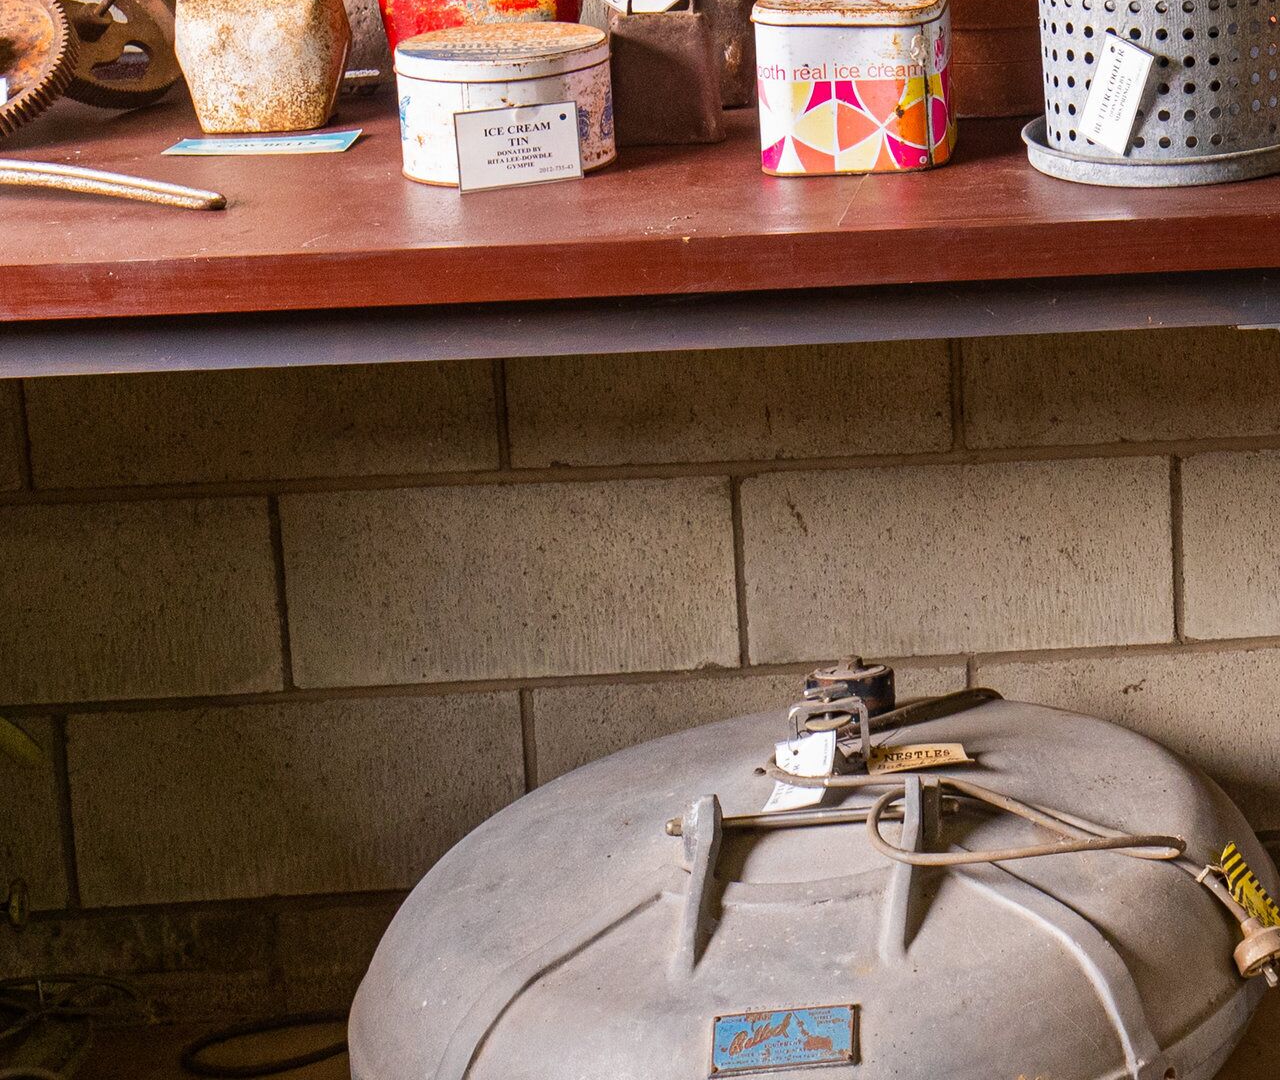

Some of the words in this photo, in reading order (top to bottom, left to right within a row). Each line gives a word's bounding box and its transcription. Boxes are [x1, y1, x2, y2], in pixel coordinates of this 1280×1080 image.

[793, 63, 826, 81] real
[835, 63, 859, 79] ice
[867, 64, 924, 77] cream
[1108, 49, 1125, 92] COOLER
[484, 127, 505, 137] ICE
[507, 122, 551, 135] CREAM
[508, 136, 529, 147] TIN
[497, 148, 530, 156] DONATED
[487, 157, 504, 165] RITA
[506, 153, 553, 164] LEE-DOWDLE
[507, 162, 535, 170] GYMPIE
